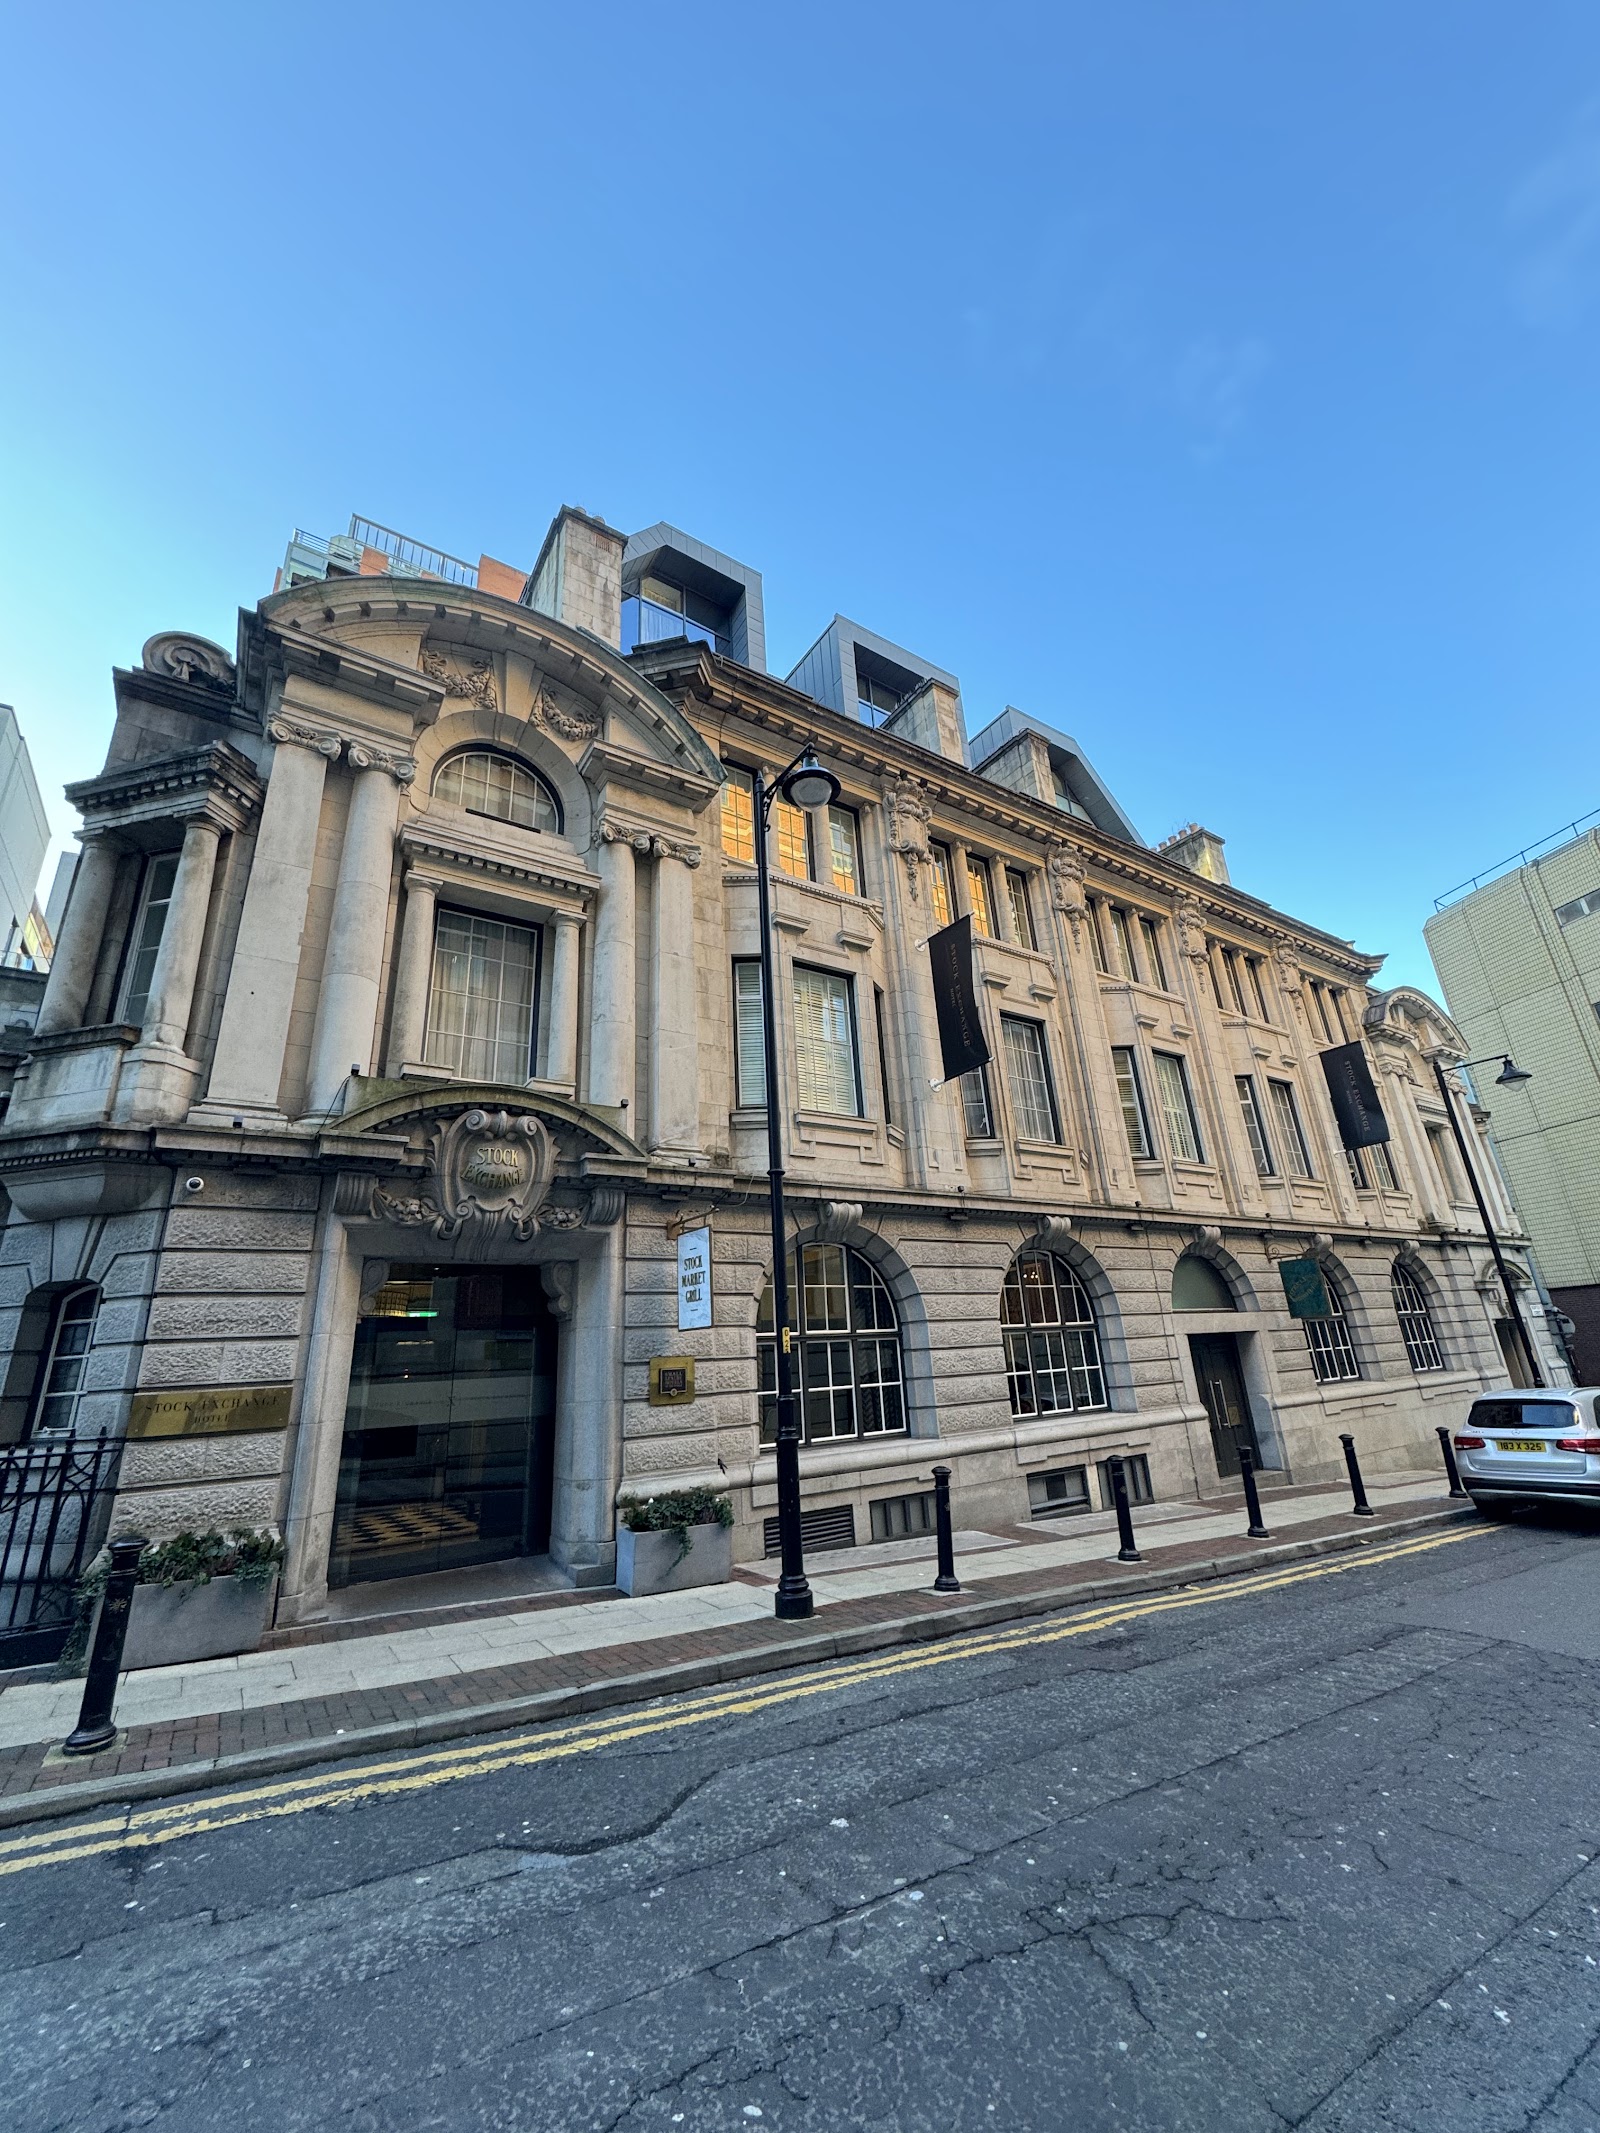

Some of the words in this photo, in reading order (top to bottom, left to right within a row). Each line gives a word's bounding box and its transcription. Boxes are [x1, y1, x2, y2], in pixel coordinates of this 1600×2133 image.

[949, 942, 960, 980] STOCK
[954, 984, 971, 1048] EXCHANGE
[1344, 1060, 1357, 1087] STOCK
[1353, 1089, 1371, 1132] EXCHANGE
[477, 1147, 519, 1167] STOCK
[460, 1162, 525, 1189] EXCHANGE
[683, 1254, 703, 1272] STOCK
[681, 1270, 706, 1288] MARKET
[685, 1287, 703, 1304] GRILL
[145, 1400, 193, 1413] STOCK
[201, 1396, 281, 1410] EXCHANGE
[193, 1414, 230, 1424] HOTEL
